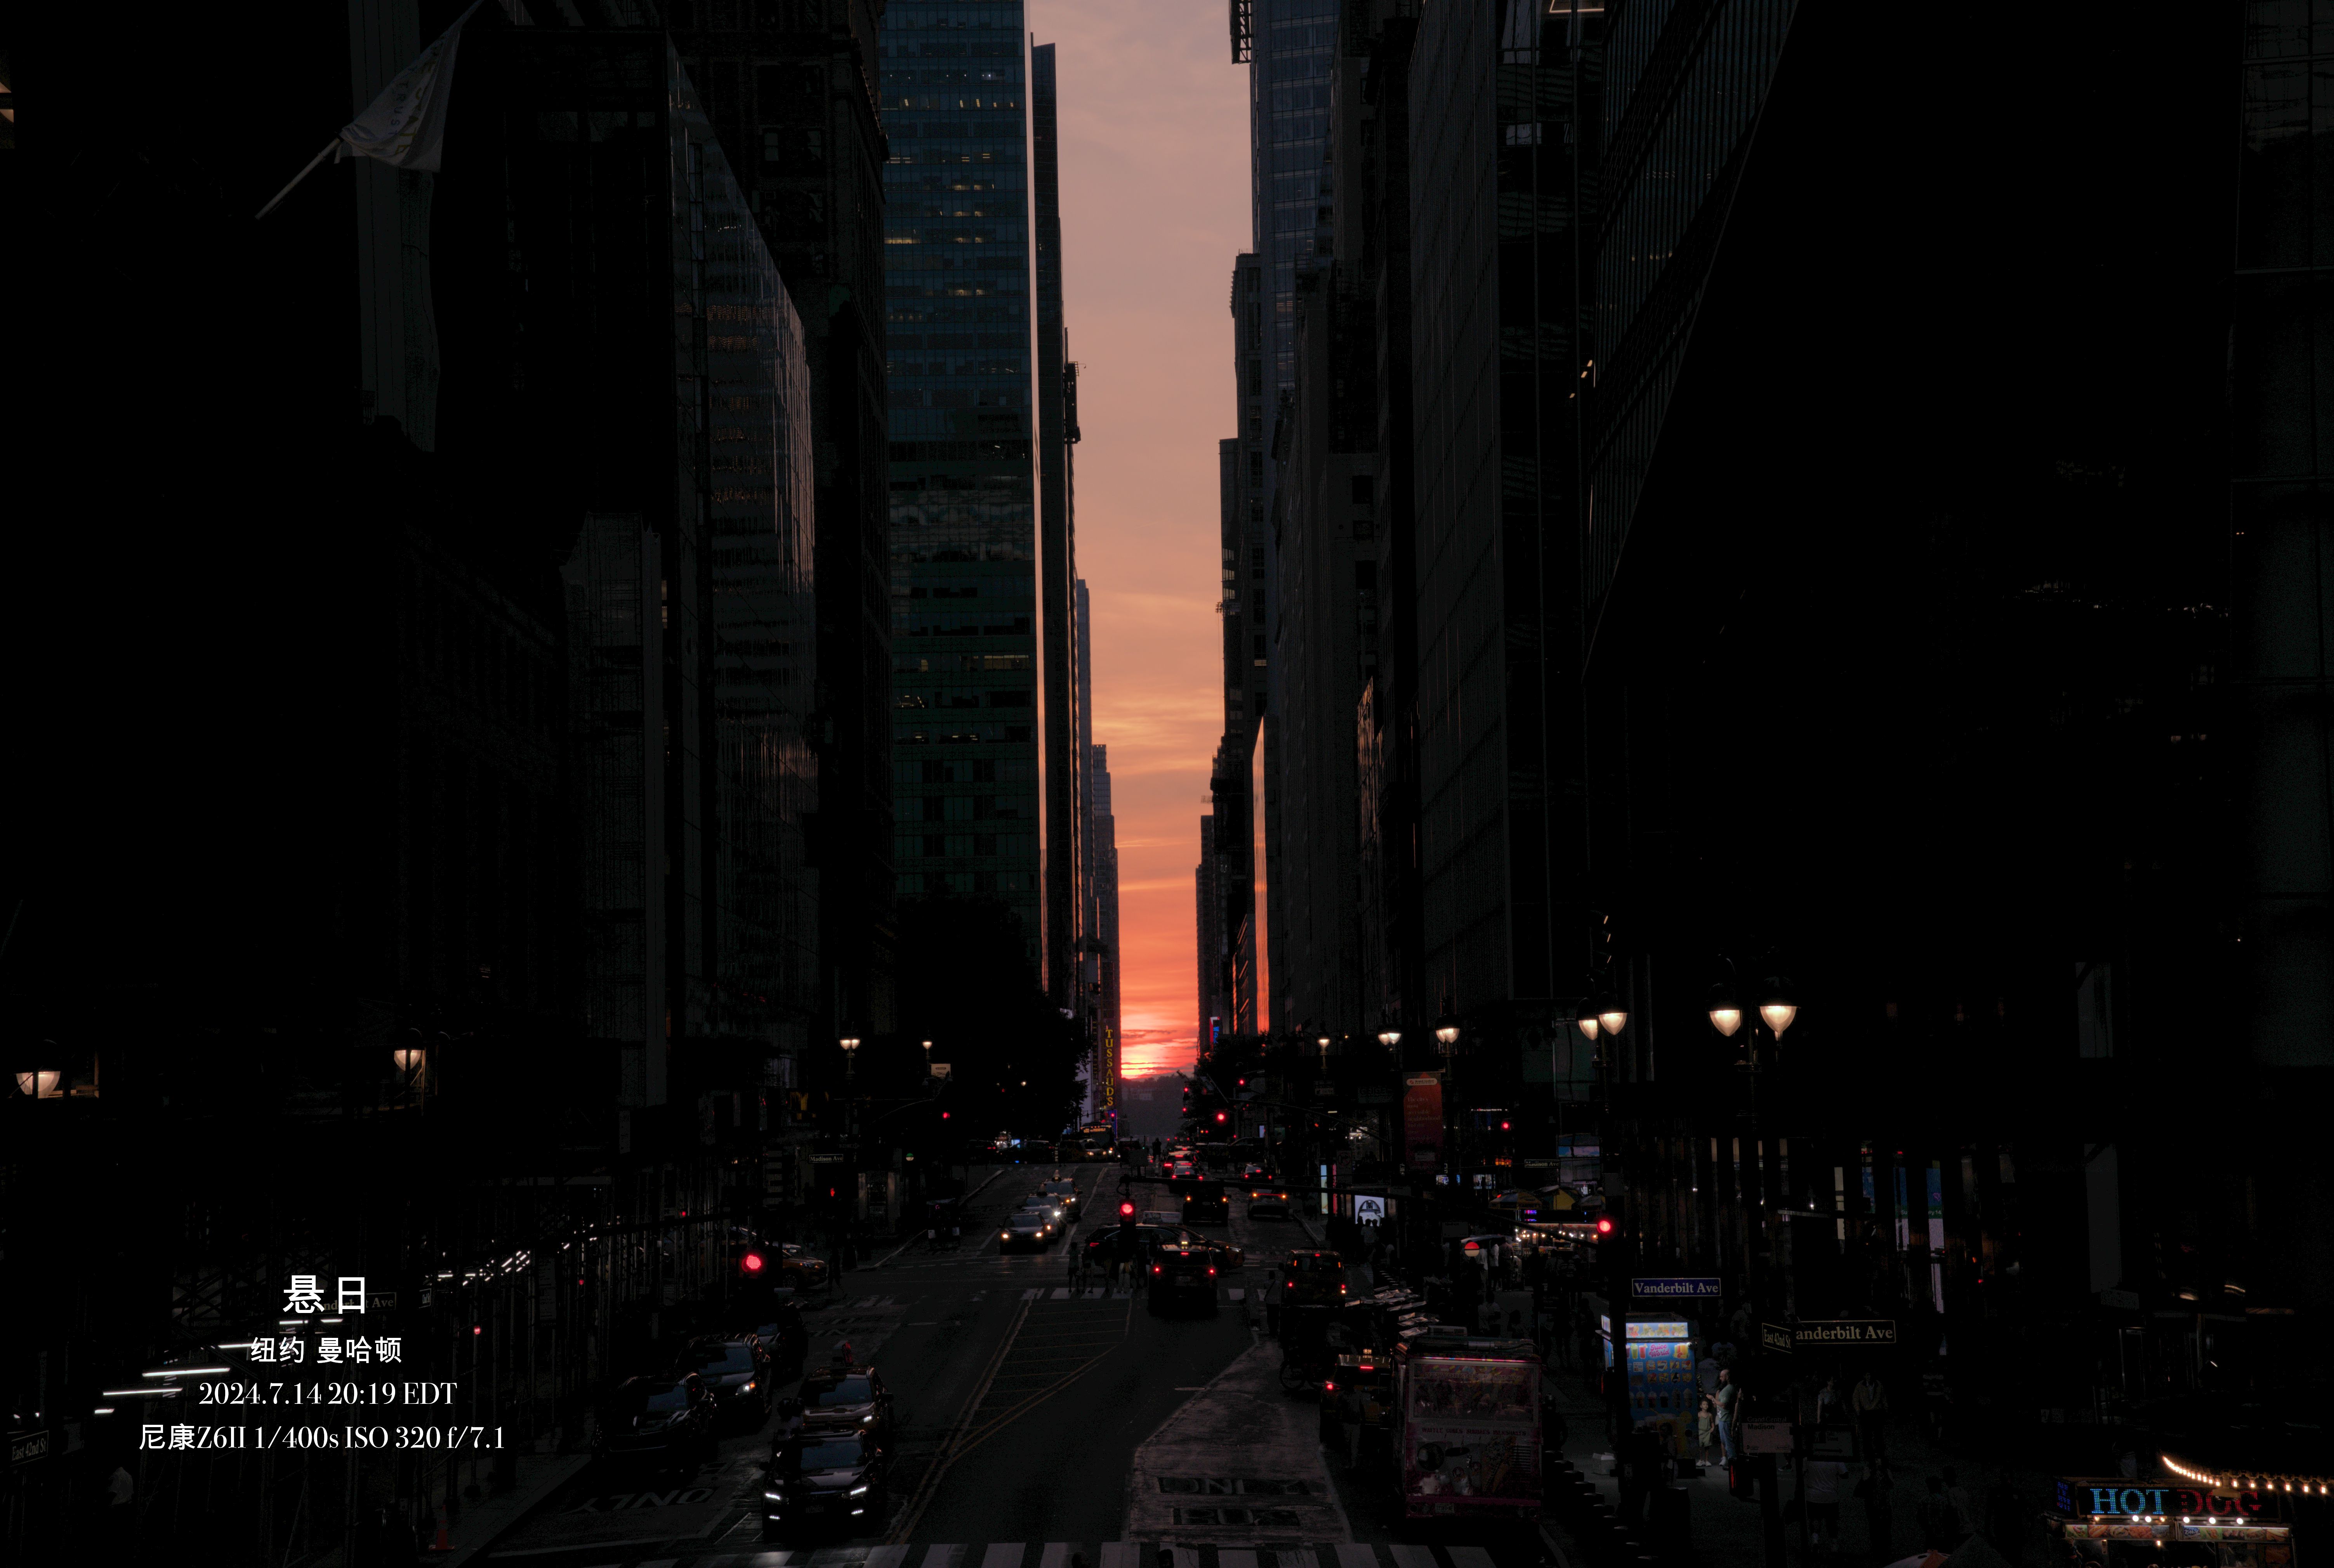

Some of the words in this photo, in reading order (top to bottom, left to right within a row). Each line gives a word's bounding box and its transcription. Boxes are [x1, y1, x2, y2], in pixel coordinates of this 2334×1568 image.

[1105, 1029, 1114, 1106] TUSSAUDS
[1634, 1282, 1694, 1294] Vanderbilt
[1697, 1282, 1718, 1293] Ave
[371, 1297, 394, 1308] Ave
[1764, 1332, 1773, 1346] East
[1774, 1334, 1784, 1348] 42nd
[1785, 1336, 1792, 1349] St
[1796, 1325, 1863, 1340] anderbilt
[1865, 1325, 1893, 1339] Ave
[1649, 1349, 1670, 1357] World
[12, 1445, 24, 1461] East
[25, 1439, 40, 1457] 42nd
[40, 1438, 47, 1453] St
[2089, 1488, 2169, 1514] HOT
[2176, 1488, 2262, 1516] DOG
